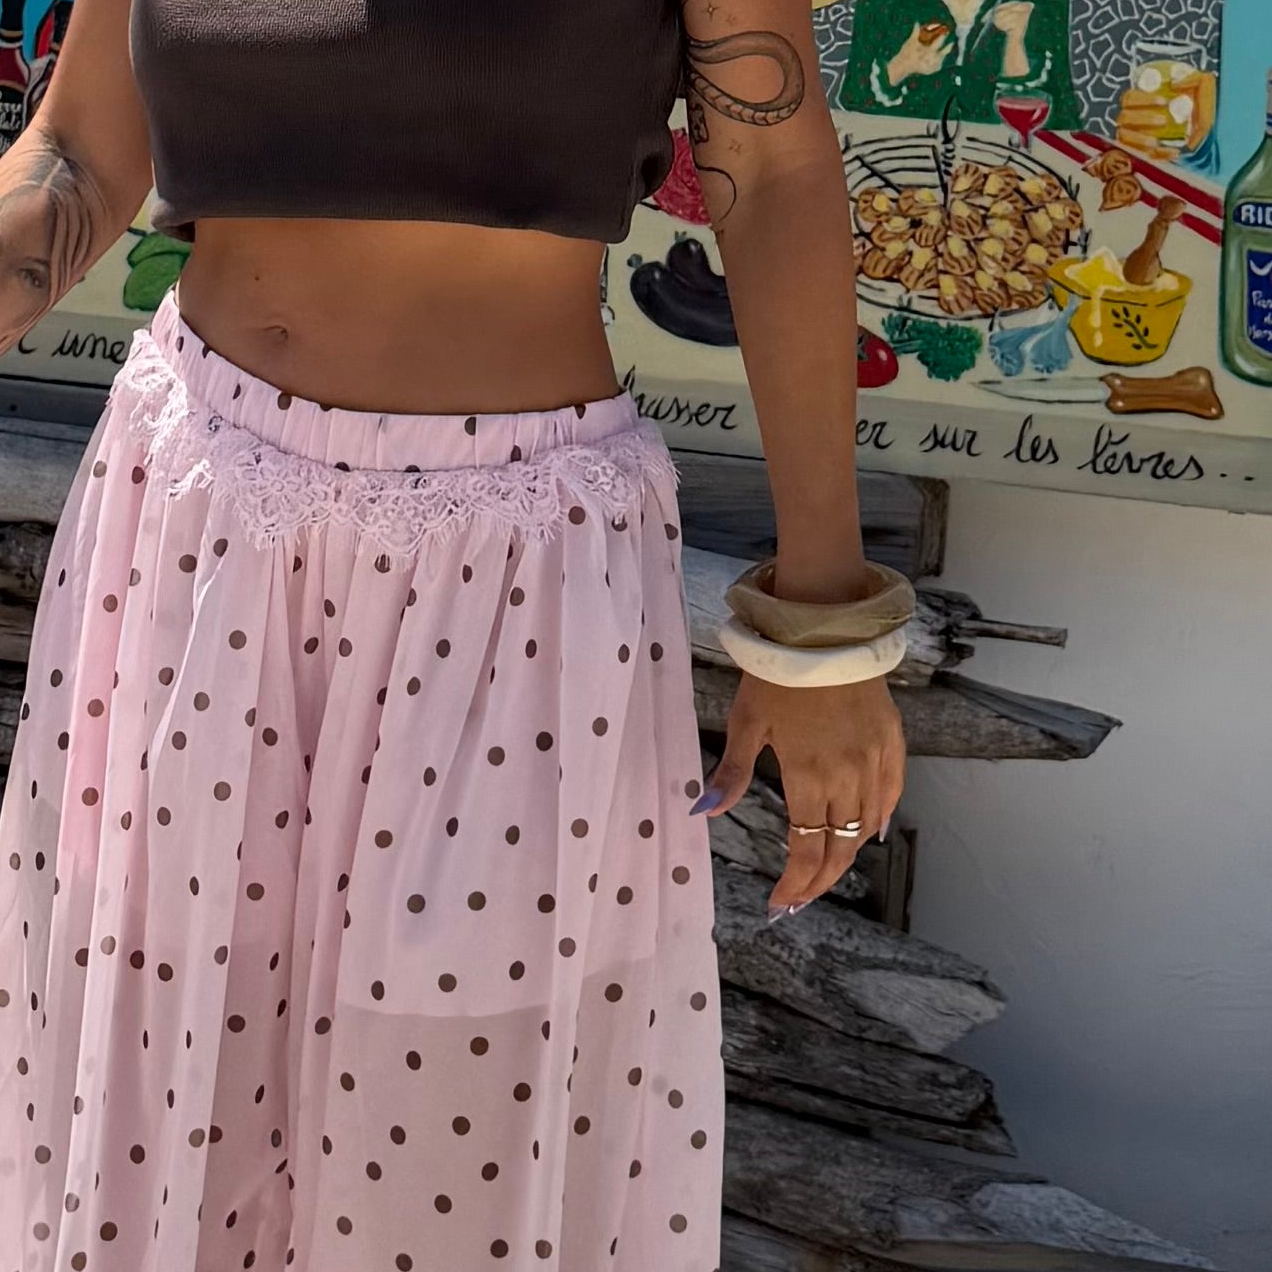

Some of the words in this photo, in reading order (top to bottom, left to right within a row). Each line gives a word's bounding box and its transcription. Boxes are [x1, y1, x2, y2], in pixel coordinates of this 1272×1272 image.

[51, 329, 126, 365] une
[855, 419, 895, 450] er
[919, 423, 982, 457] sur
[1003, 414, 1060, 465] les
